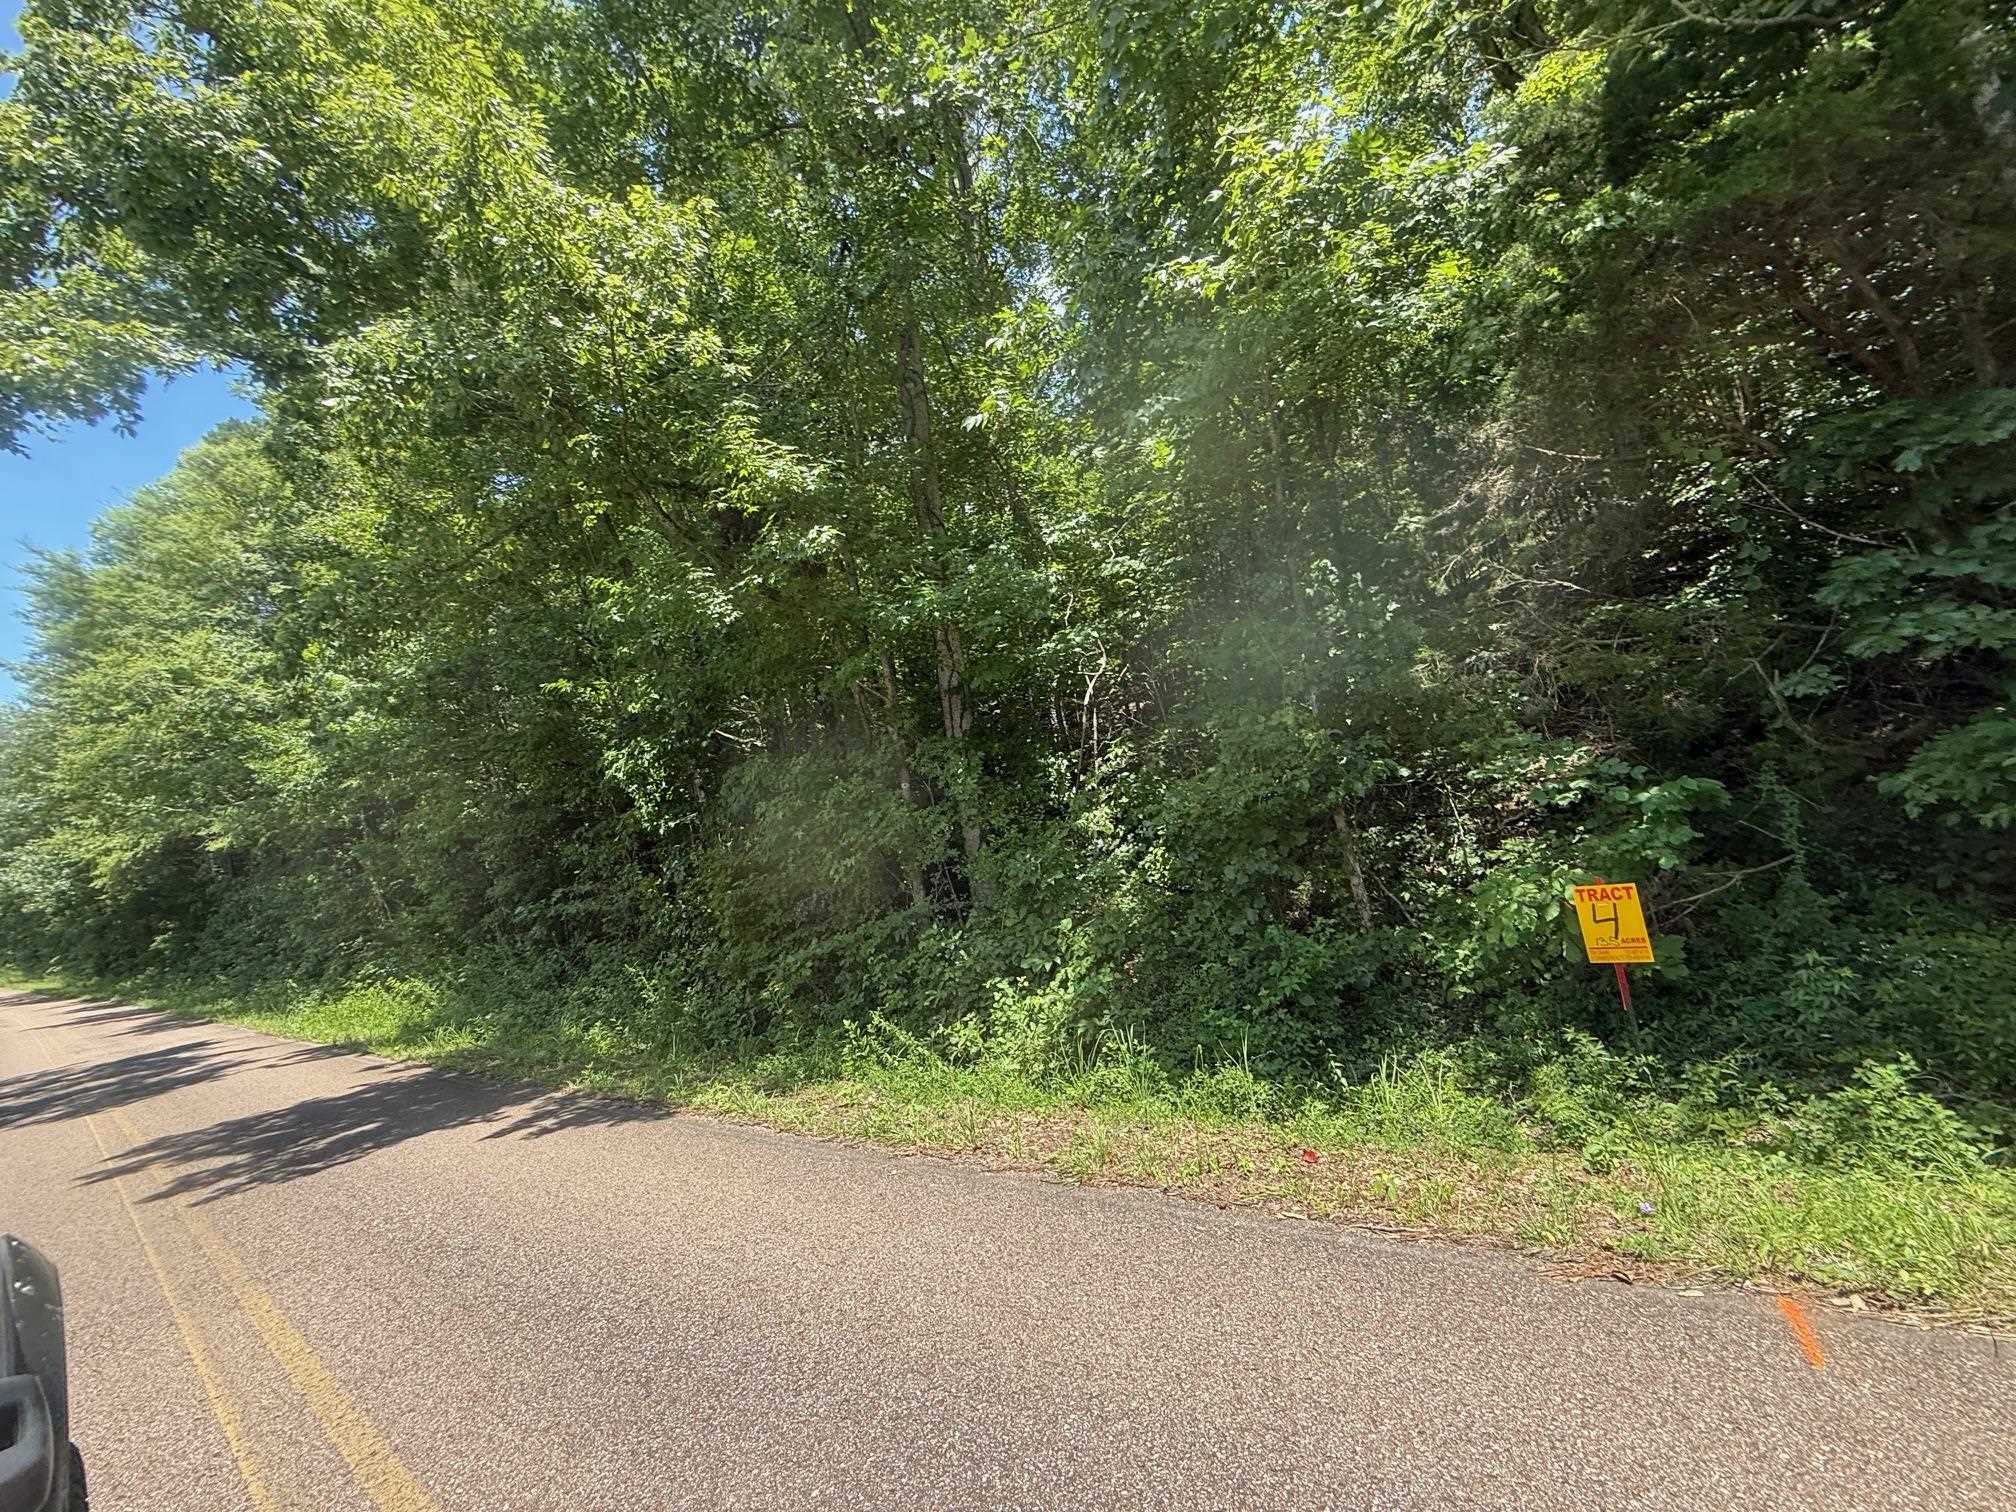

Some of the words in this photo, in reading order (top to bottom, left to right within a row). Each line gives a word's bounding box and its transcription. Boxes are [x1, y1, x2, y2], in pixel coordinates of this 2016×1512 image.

[1575, 887, 1633, 902] TRACT
[1592, 902, 1619, 940] 4
[1621, 936, 1647, 945] ACRES
